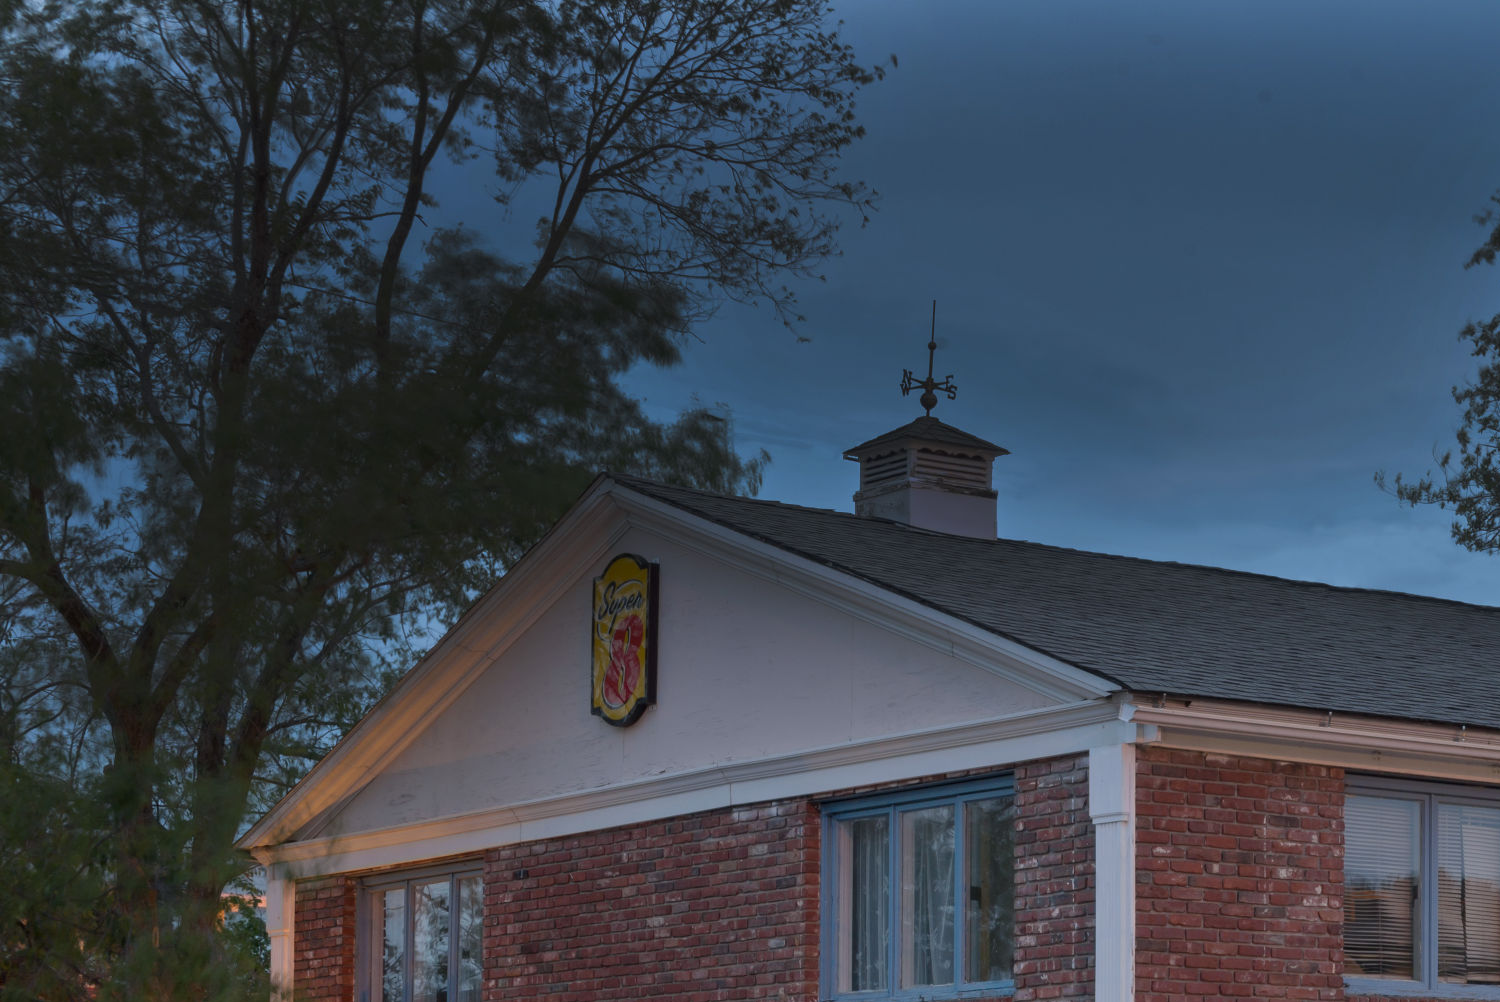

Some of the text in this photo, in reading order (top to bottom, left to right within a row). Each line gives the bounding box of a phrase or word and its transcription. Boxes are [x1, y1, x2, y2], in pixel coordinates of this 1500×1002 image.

[947, 385, 957, 400] S
[597, 580, 643, 642] Super
[602, 614, 644, 710] 8
